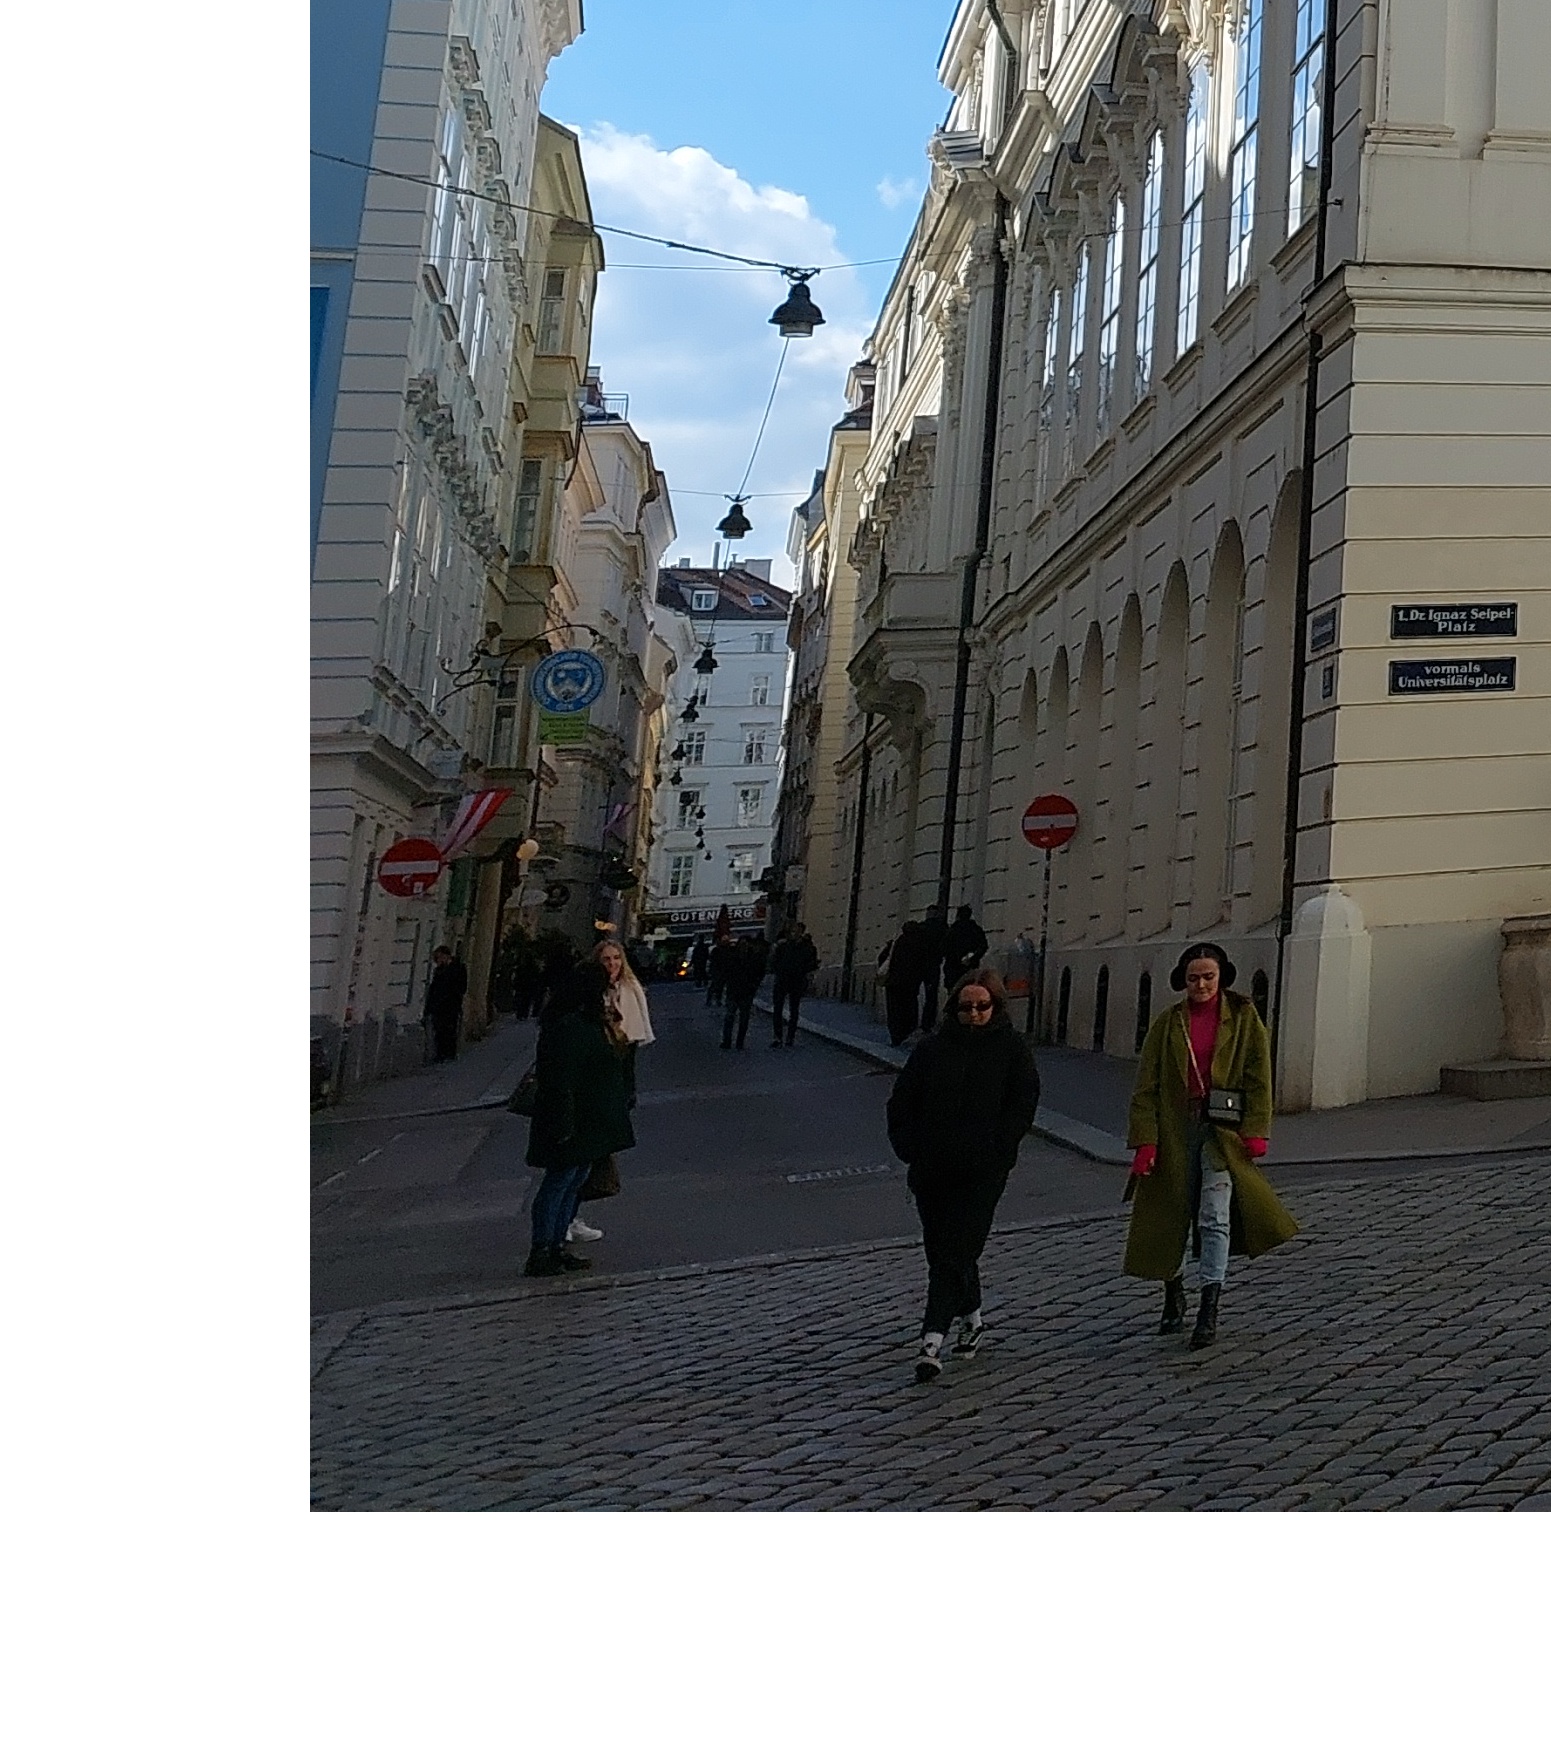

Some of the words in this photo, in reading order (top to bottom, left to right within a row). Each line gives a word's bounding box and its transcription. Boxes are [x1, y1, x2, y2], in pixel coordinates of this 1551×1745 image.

[1428, 609, 1468, 623] Ignaz
[1437, 620, 1476, 633] Platz
[1424, 661, 1481, 675] vormals
[1398, 672, 1508, 688] Universitätsplatz
